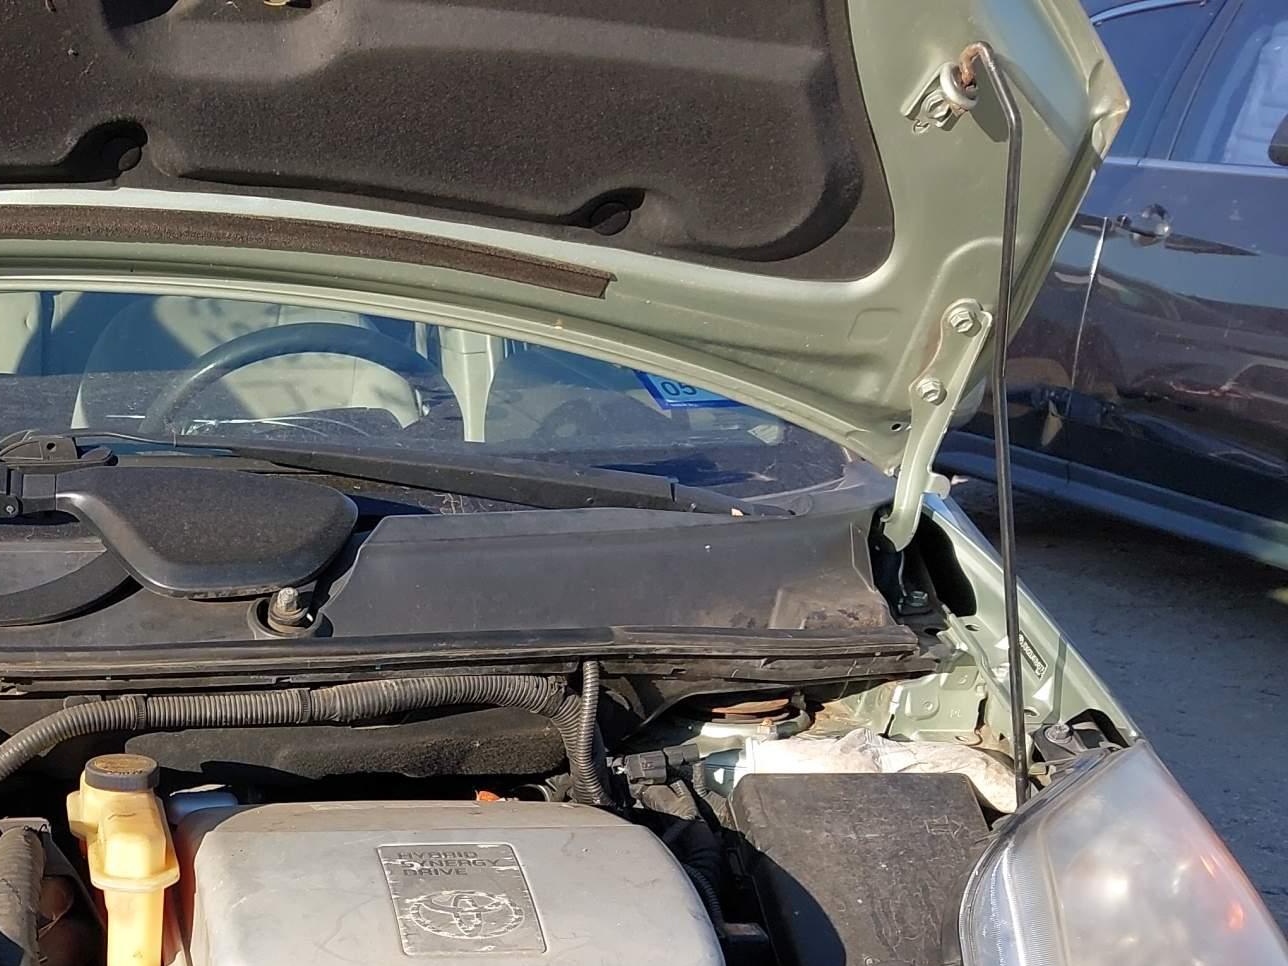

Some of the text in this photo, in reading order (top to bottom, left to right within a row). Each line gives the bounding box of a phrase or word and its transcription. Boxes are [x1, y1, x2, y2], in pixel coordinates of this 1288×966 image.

[661, 381, 697, 396] 05
[398, 851, 479, 860] HYBRID
[400, 859, 501, 868] SYNERGY
[403, 868, 468, 877] DRIVE
